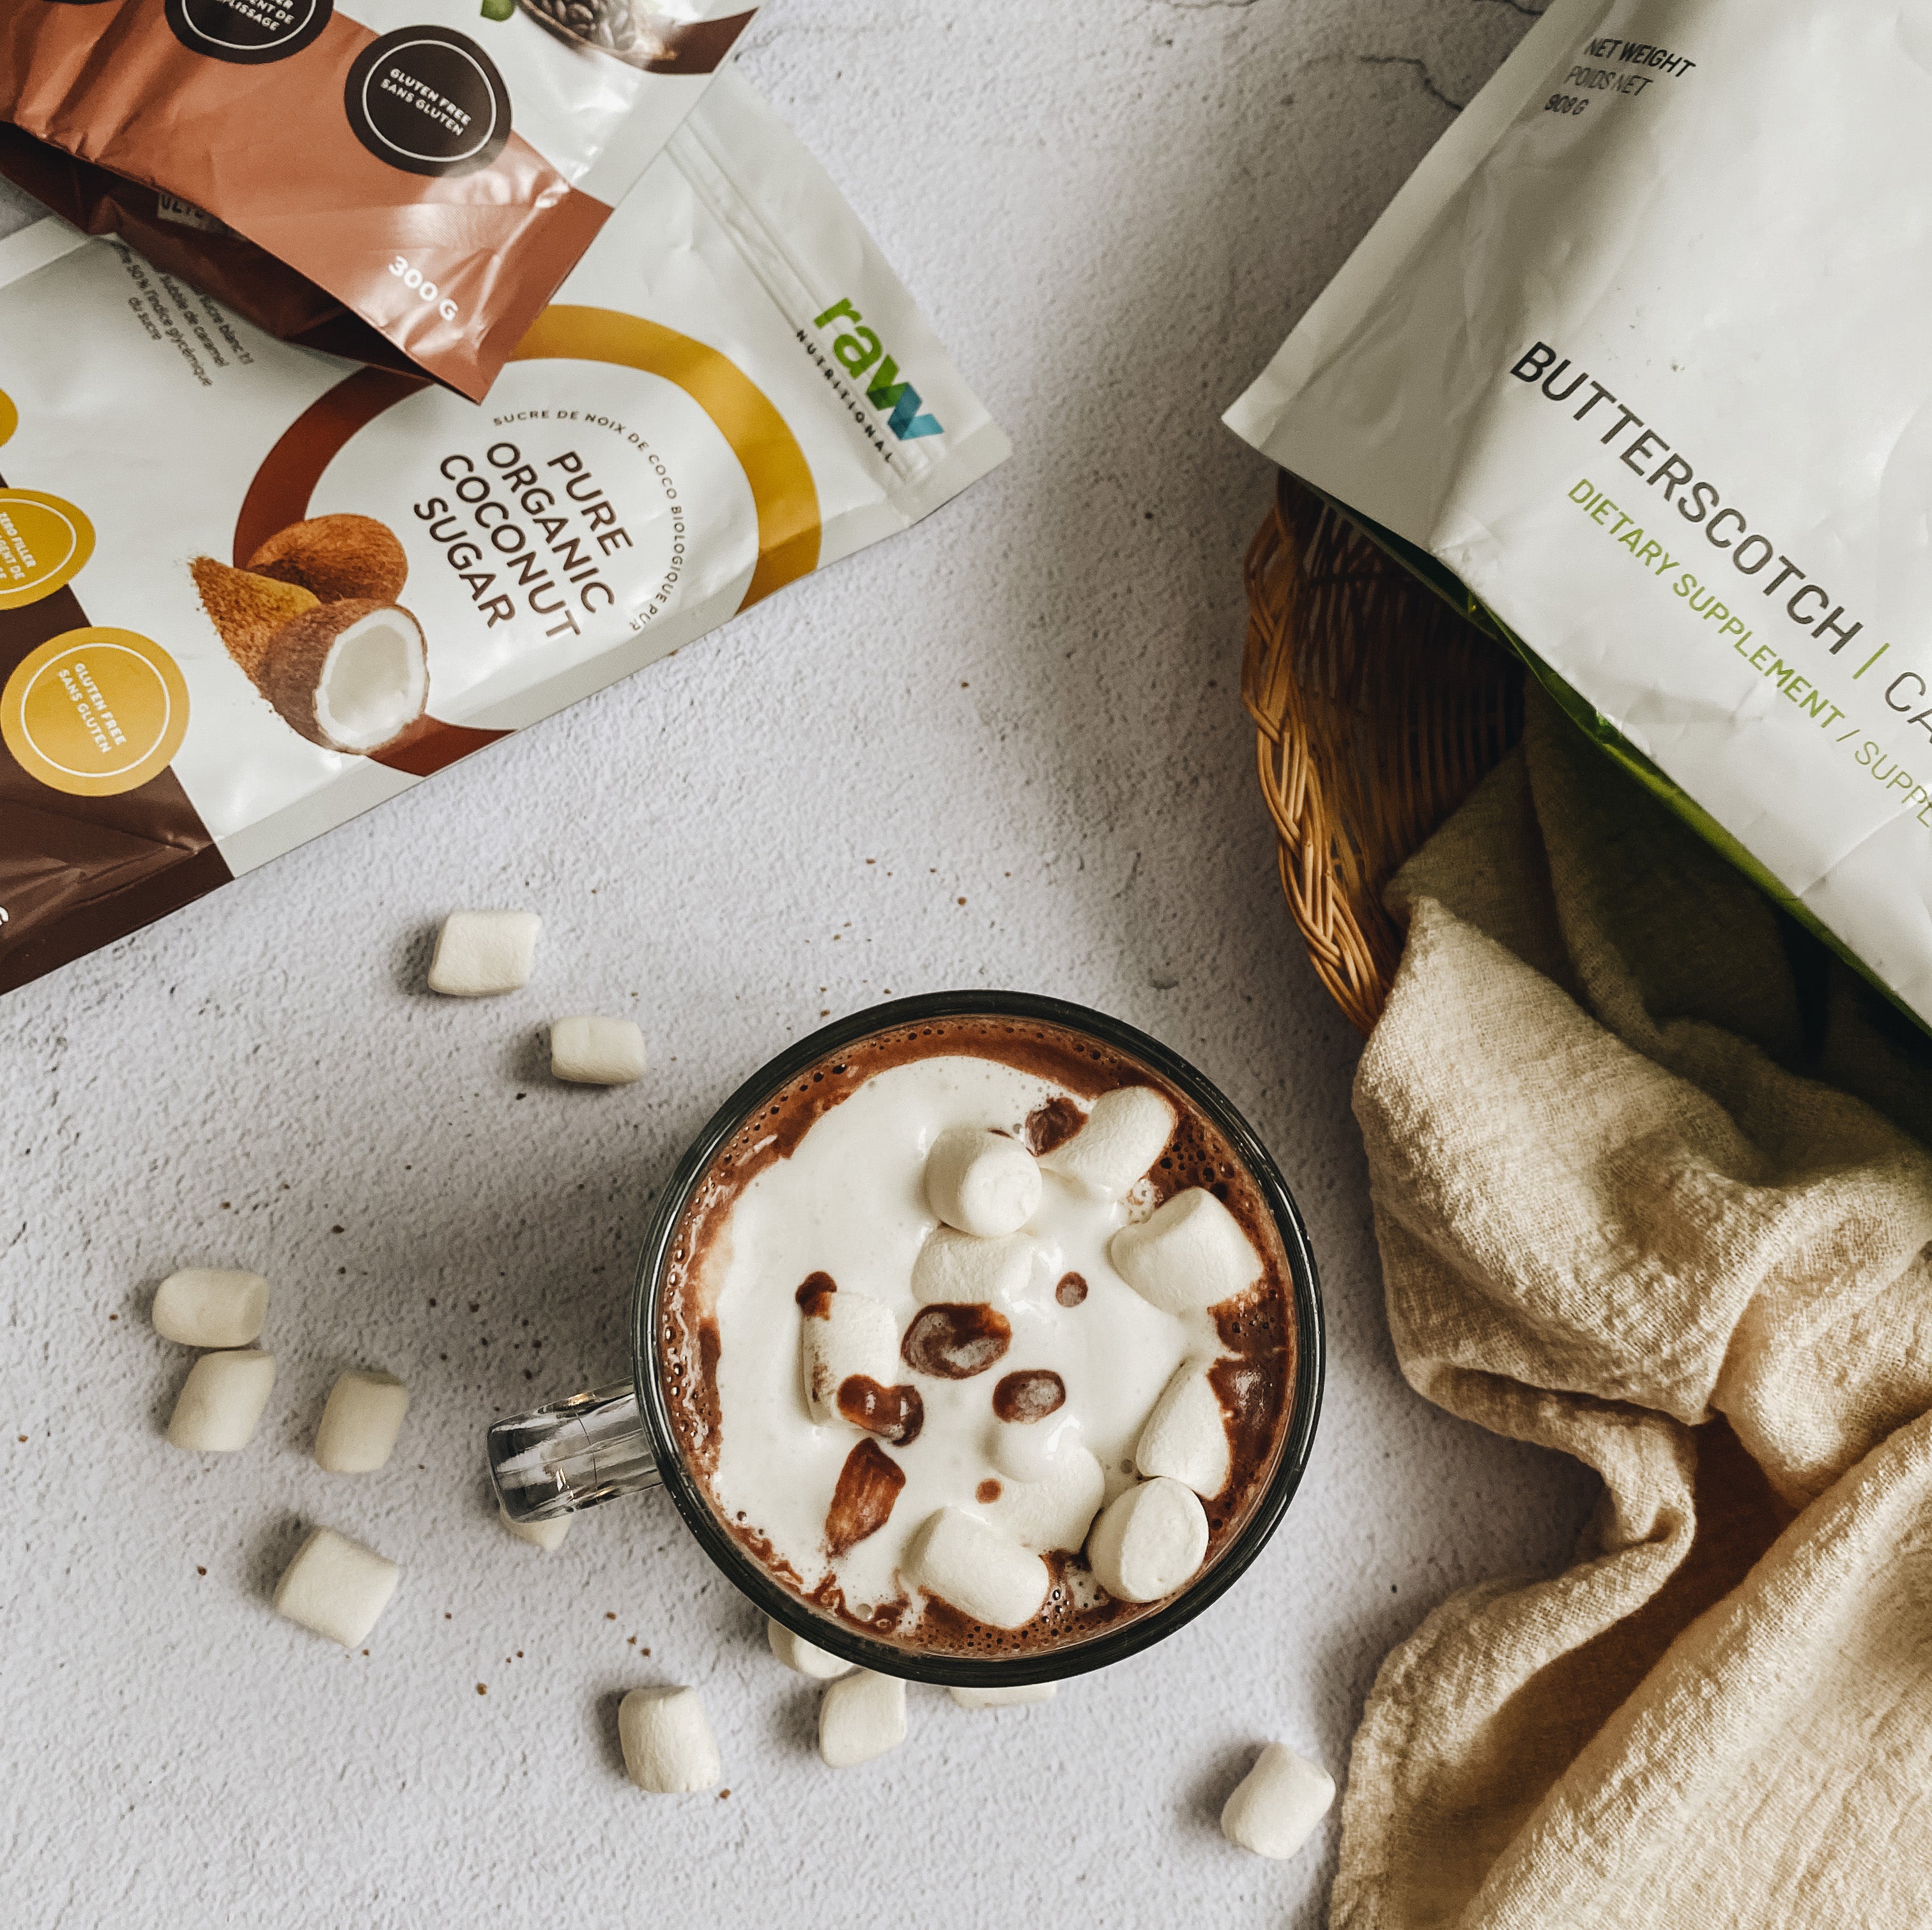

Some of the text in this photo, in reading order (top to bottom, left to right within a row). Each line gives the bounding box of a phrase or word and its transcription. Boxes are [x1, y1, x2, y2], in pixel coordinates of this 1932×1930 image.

[275, 9, 295, 25] DE
[1583, 37, 1697, 77] NET WEIGHT
[380, 78, 464, 137] SANS GLUTEN
[390, 68, 472, 126] GLUTEN FREE
[1564, 65, 1653, 96] POIDS NET
[388, 255, 459, 321] 300 G
[194, 326, 230, 367] caramel
[813, 296, 946, 441] raw
[795, 328, 893, 464] NUTRITIONAL
[486, 441, 616, 614] ORGANIC
[493, 409, 686, 631] SUCRE DE NOIX DE COCO BIOLOGIQUE PUR
[546, 450, 634, 557] PURE
[1508, 340, 1864, 655] BUTTERSCOTCH
[10, 565, 26, 580] DE
[12, 537, 36, 568] FILLER
[413, 496, 517, 629] SUGAR
[440, 454, 581, 640] COCONUT
[1567, 478, 1681, 577] DIETARY
[1673, 572, 1846, 730] SUPPLEMENT
[58, 669, 112, 754] SANS GLUTEN
[74, 662, 127, 746] GLUTEN FREE
